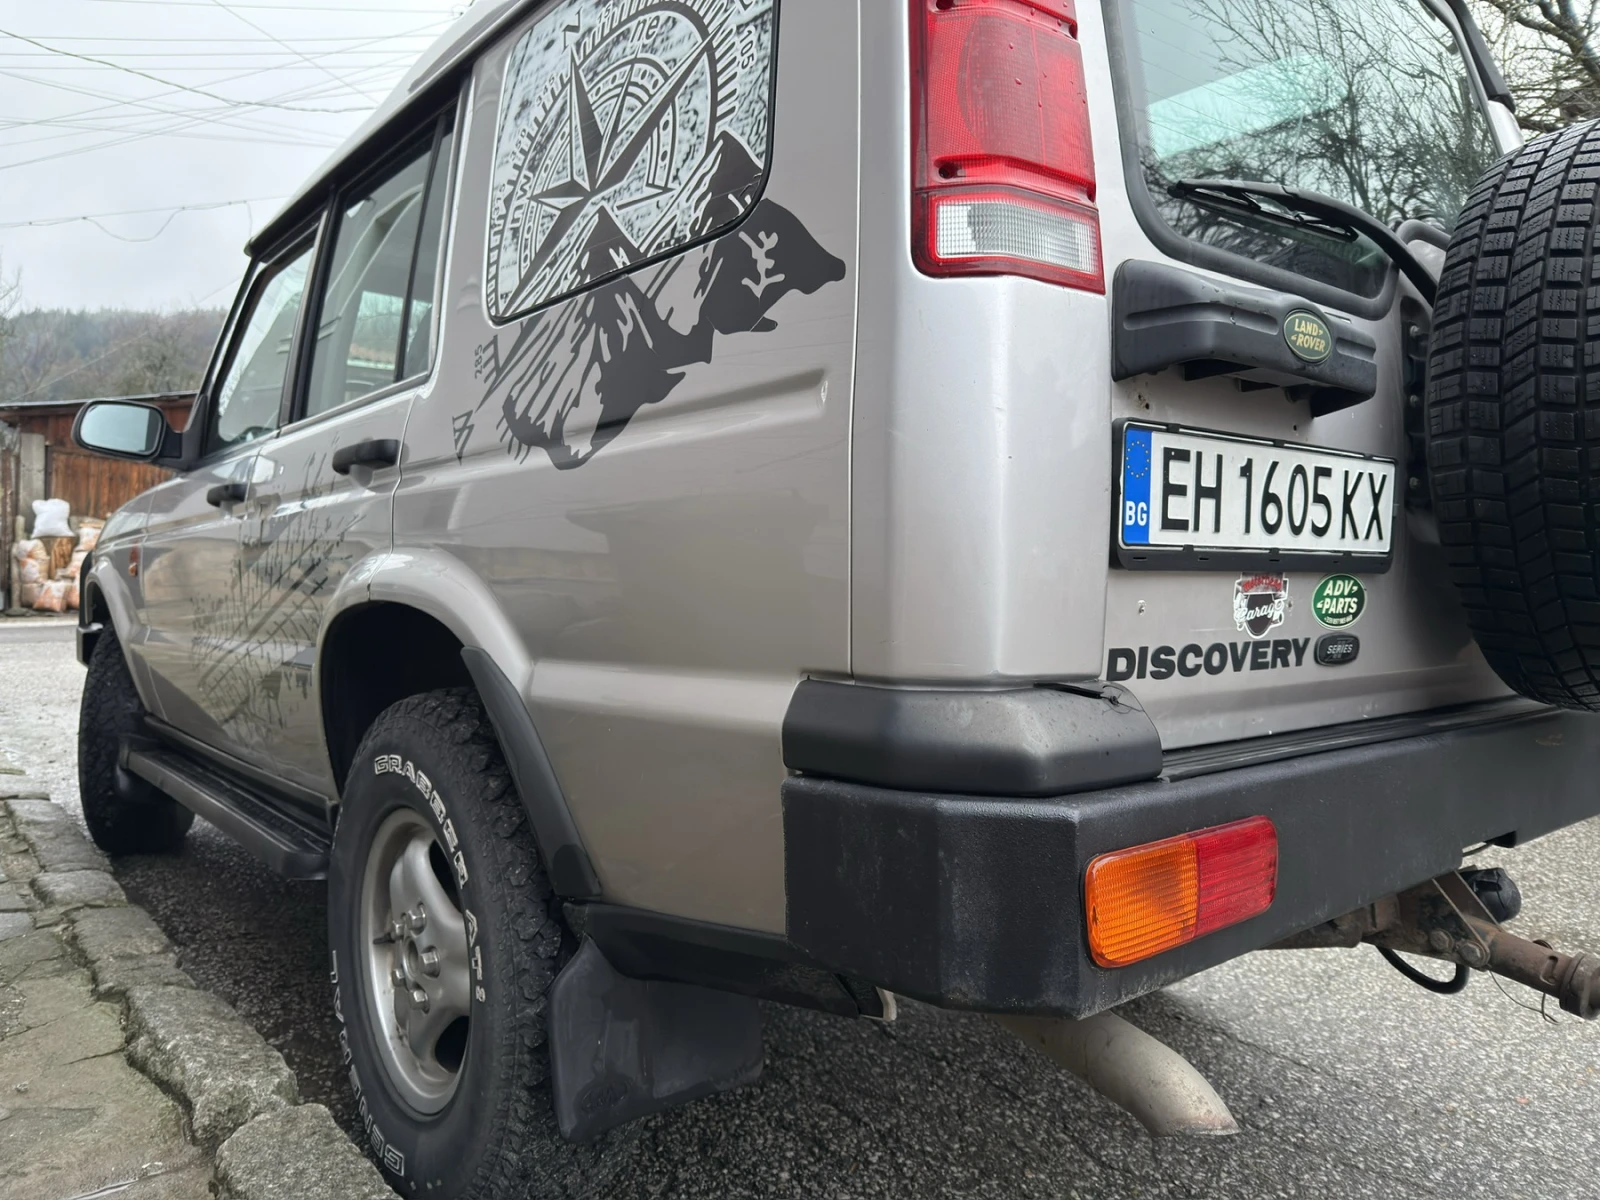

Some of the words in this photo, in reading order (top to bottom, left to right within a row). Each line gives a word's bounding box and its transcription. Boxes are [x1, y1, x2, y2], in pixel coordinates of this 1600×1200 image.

[739, 30, 755, 70] 105
[1294, 318, 1320, 336] LAND
[1296, 333, 1326, 353] ROVER
[1160, 446, 1223, 533] EH
[1239, 457, 1332, 538] 1605
[1341, 469, 1388, 541] KX
[1125, 501, 1147, 526] BG
[1106, 637, 1311, 681] DISCOVERY
[1327, 644, 1353, 654] SERIES
[374, 754, 468, 889] GRABBER
